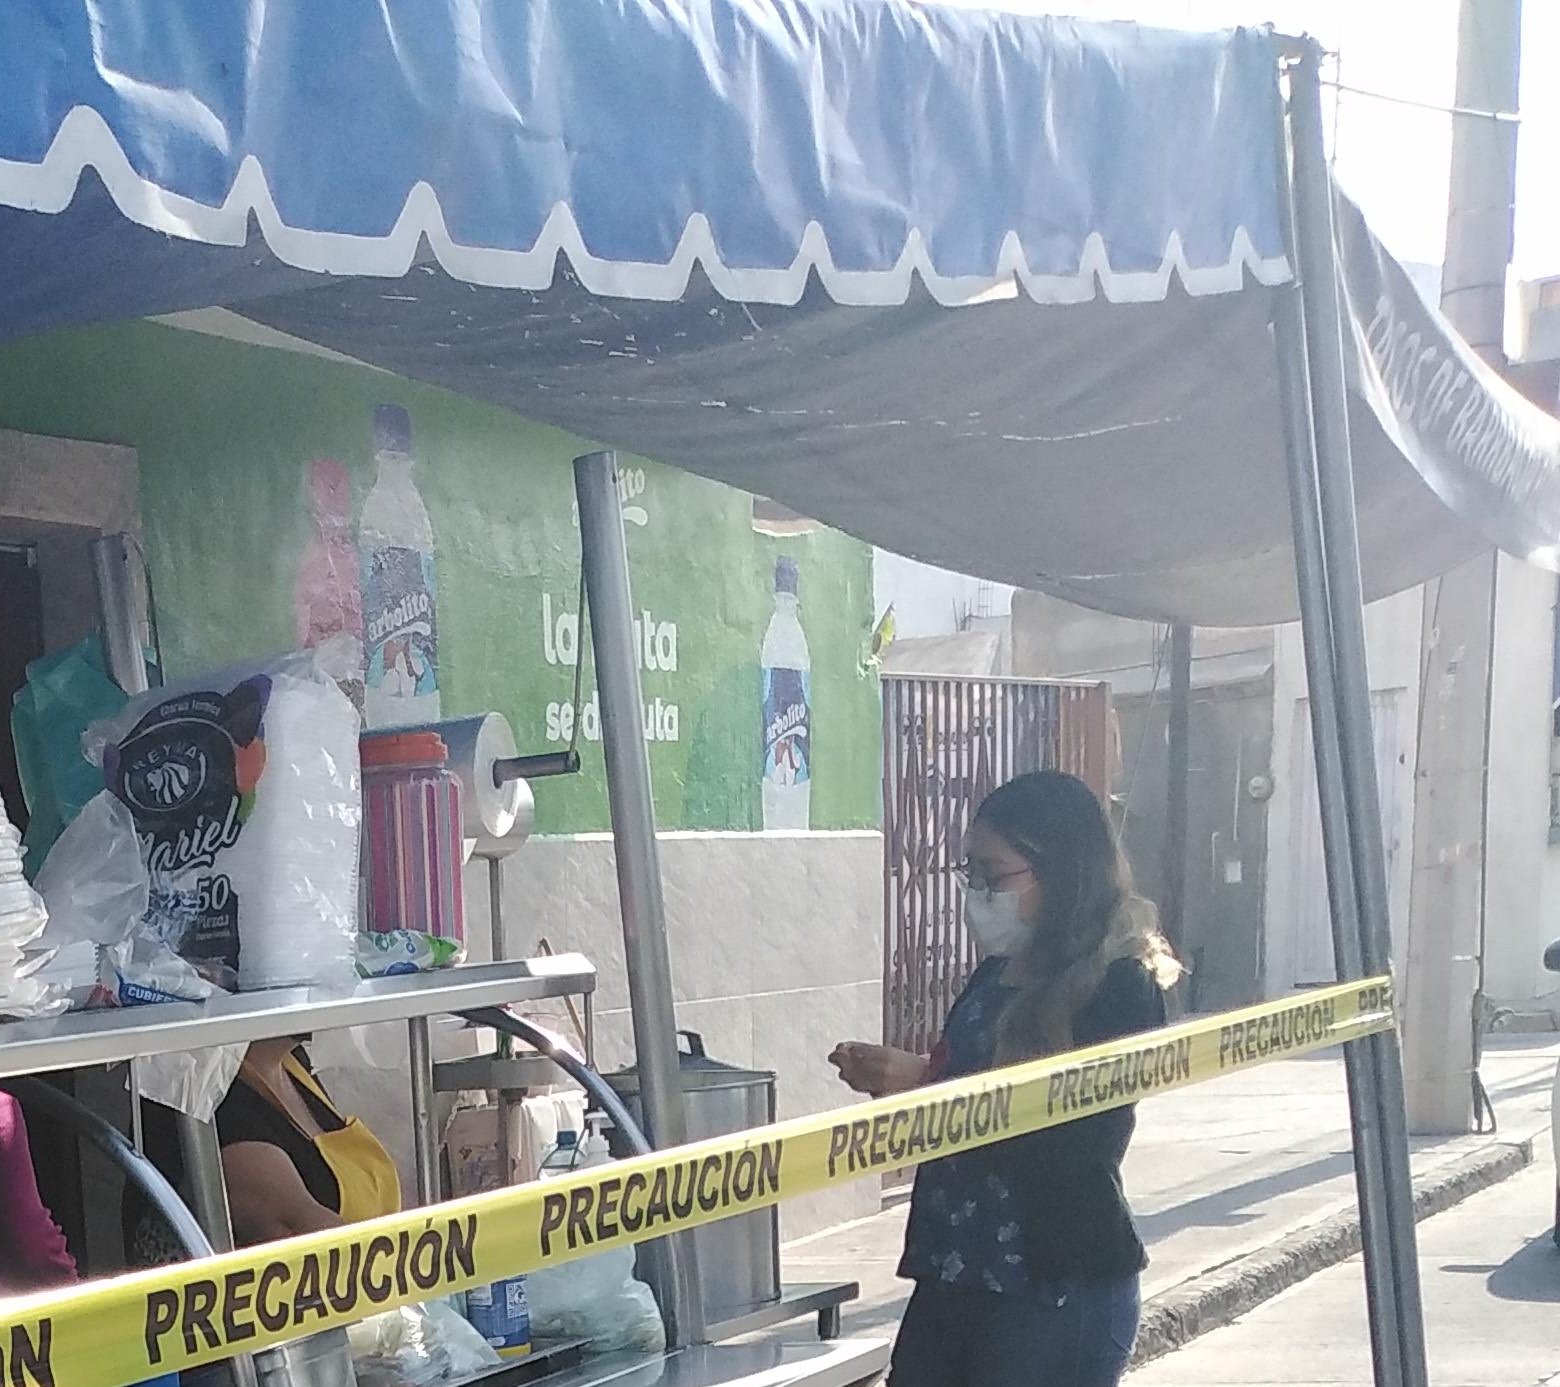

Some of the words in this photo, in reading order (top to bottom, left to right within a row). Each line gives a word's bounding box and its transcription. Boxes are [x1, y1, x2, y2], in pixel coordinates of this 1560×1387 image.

[197, 876, 230, 912] 50
[828, 1082, 1012, 1177] PRECAUCIÓN
[541, 1139, 782, 1256] PRECAUCIÓN
[145, 1214, 477, 1365] PRECAUCIÓN
